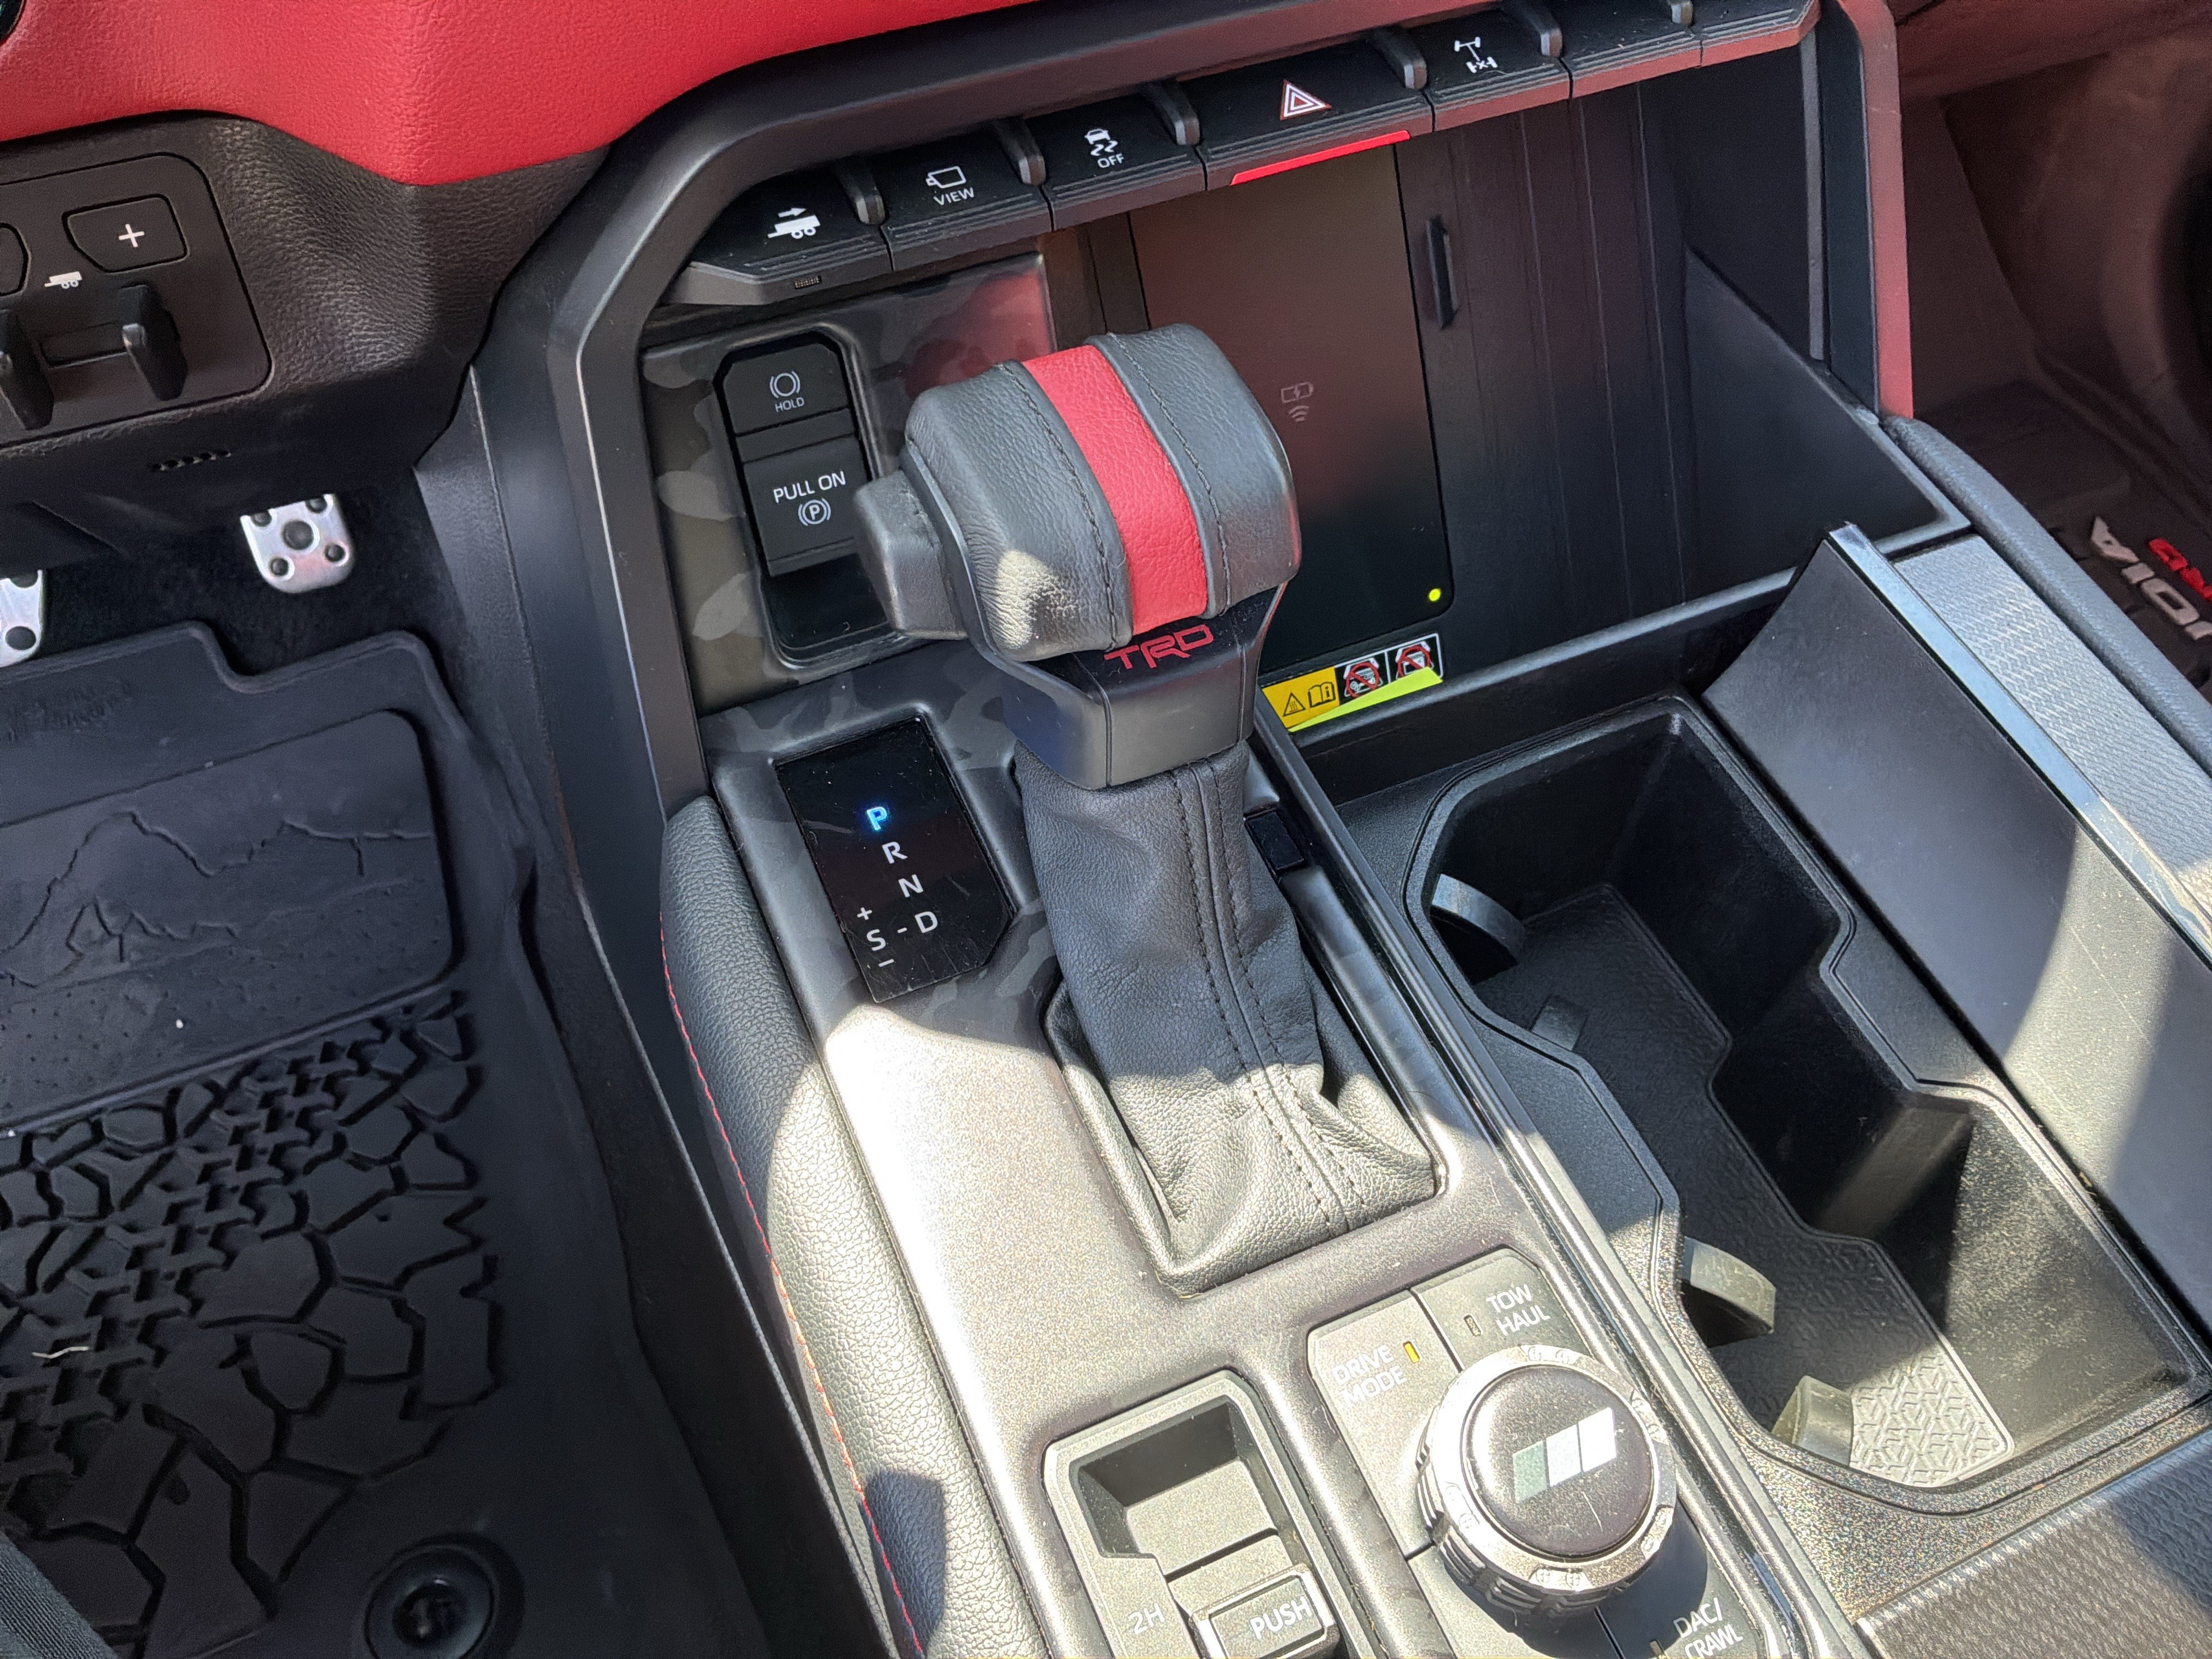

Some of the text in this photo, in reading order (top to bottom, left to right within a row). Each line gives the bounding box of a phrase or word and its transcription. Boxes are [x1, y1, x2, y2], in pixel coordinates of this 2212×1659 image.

[1098, 154, 1124, 168] OFF
[934, 188, 974, 205] VIEW
[775, 397, 804, 412] HOLD
[774, 471, 845, 503] PULL ON
[1104, 624, 1214, 669] TRD
[867, 806, 887, 830] P
[882, 842, 907, 864] R
[899, 874, 923, 897] N
[867, 929, 886, 951] S
[915, 911, 938, 933] D
[1486, 1284, 1532, 1313] TOW
[1496, 1305, 1550, 1336] HAUL
[1332, 1344, 1394, 1385] DRIVE
[1340, 1365, 1407, 1408] MODE
[1128, 1602, 1164, 1634] 2H
[1250, 1596, 1312, 1639] PUSH
[1673, 1598, 1722, 1638] DAC/
[1685, 1624, 1743, 1659] CRAWL
